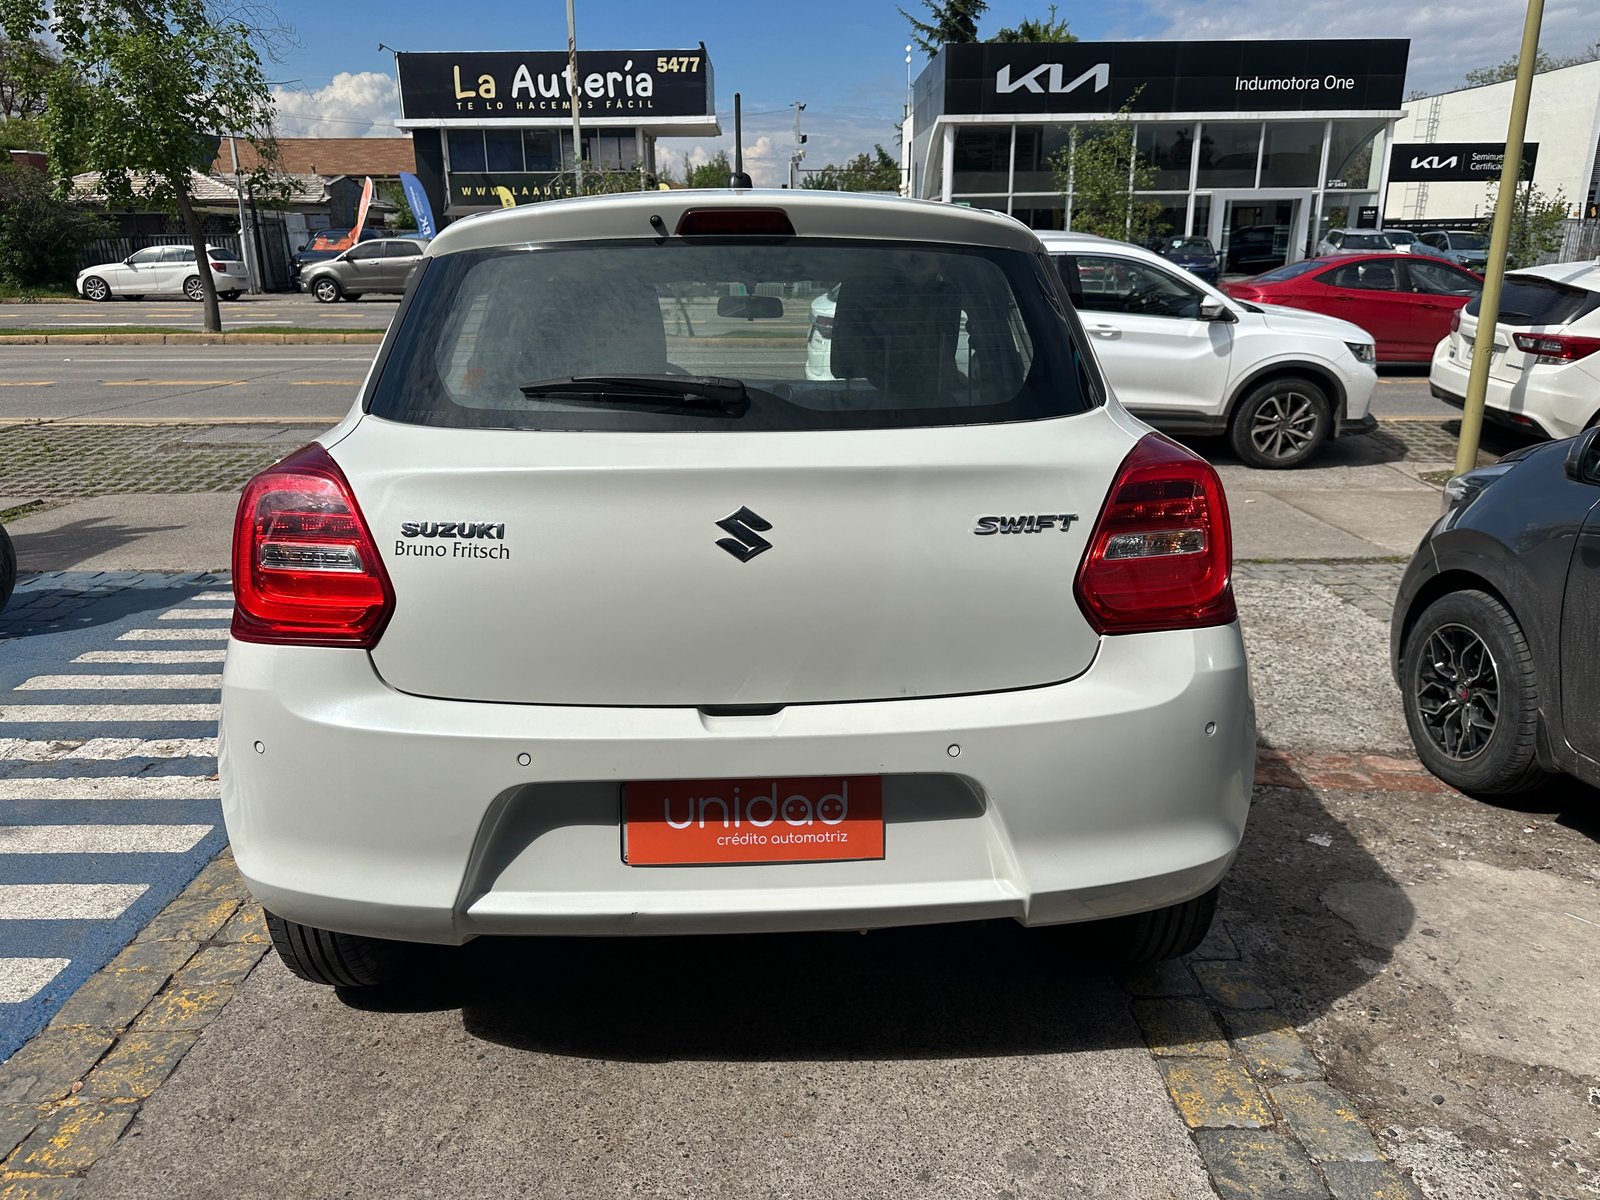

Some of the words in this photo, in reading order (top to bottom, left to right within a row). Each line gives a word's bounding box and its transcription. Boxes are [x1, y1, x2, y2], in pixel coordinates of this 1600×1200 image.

[656, 56, 700, 73] 5477
[453, 65, 496, 99] La
[511, 60, 653, 98] Autería
[996, 63, 1110, 93] KIA
[1235, 76, 1320, 91] Indumotora
[1323, 75, 1355, 90] One
[457, 102, 474, 111] TE
[487, 101, 504, 110] LO
[606, 98, 653, 109] FÁCIL
[1410, 156, 1458, 169] KIA
[1472, 152, 1504, 161] Seminue
[400, 520, 505, 540] SUZUKI
[974, 513, 1079, 535] SWIFT
[394, 540, 446, 557] Bruno
[452, 541, 510, 560] Fritsch
[664, 780, 848, 829] unidad
[716, 833, 767, 846] crédito
[771, 831, 848, 845] automotriz
